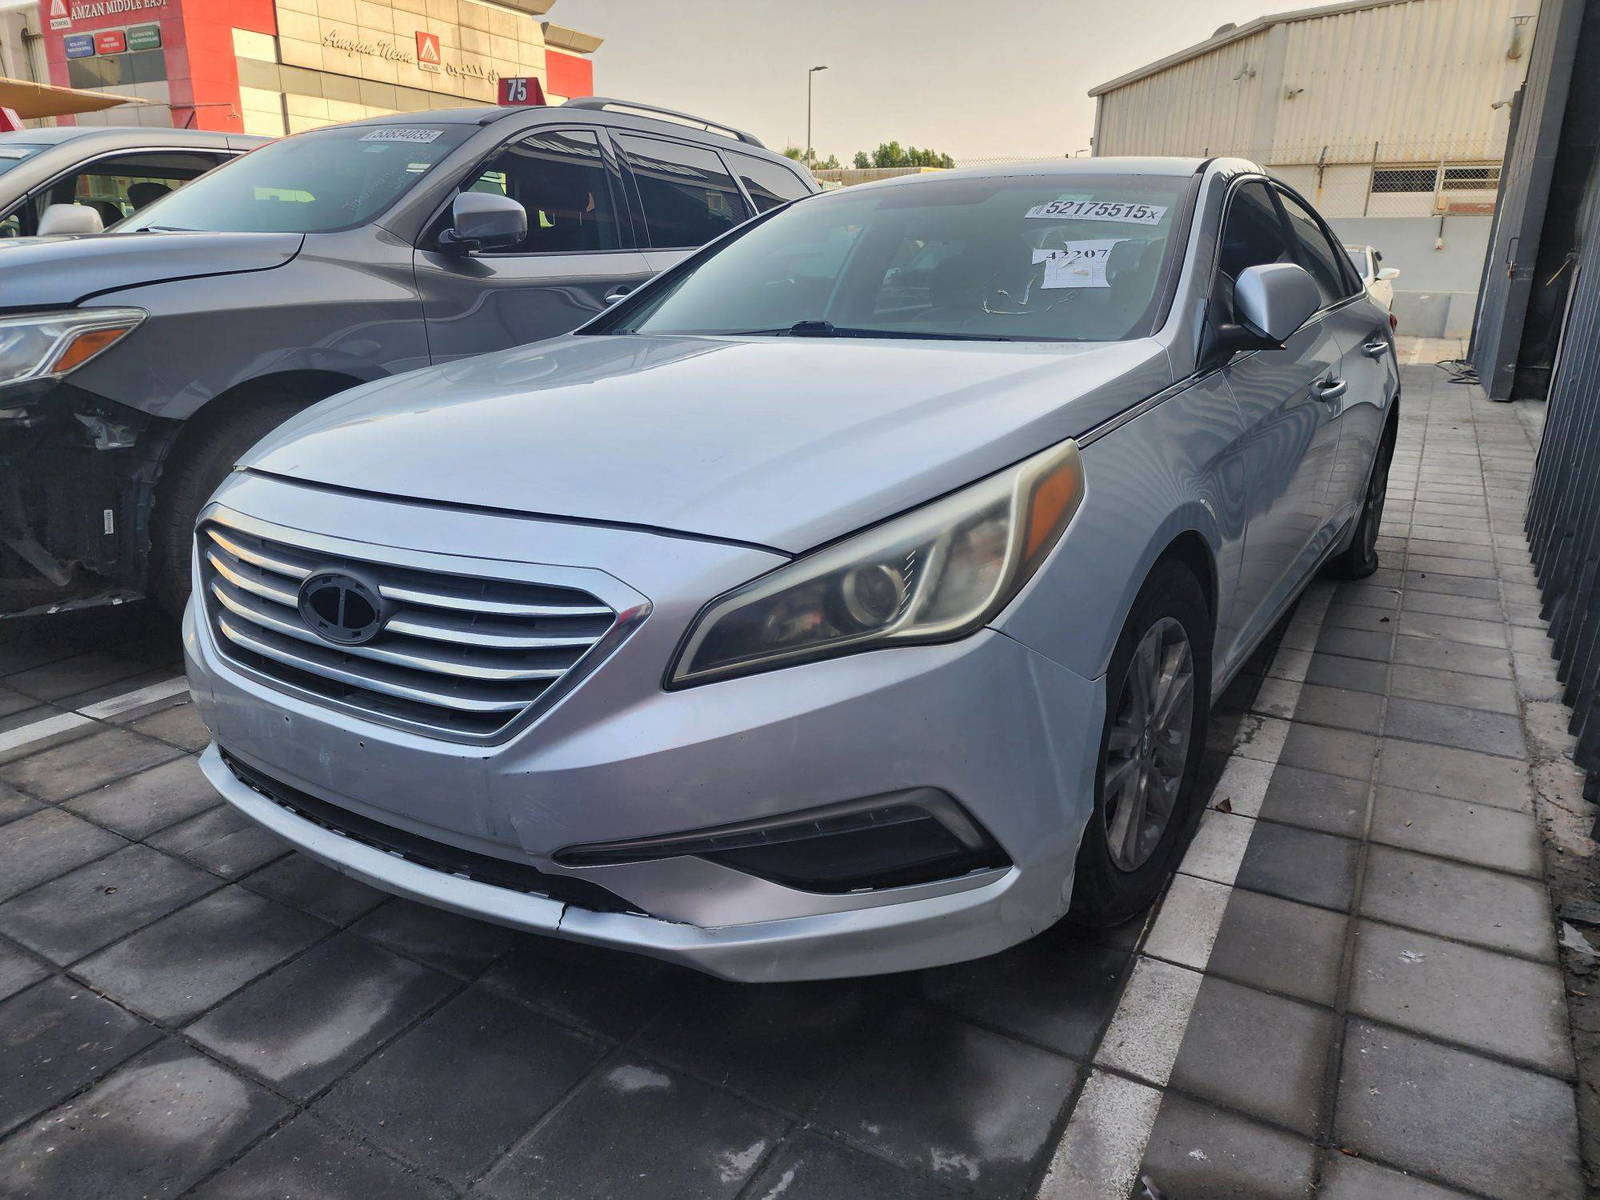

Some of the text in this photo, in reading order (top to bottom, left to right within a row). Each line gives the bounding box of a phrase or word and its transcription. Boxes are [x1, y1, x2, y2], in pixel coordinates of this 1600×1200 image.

[71, 2, 105, 20] AMZAN
[106, 0, 142, 14] MIDDLE
[507, 79, 528, 102] 75
